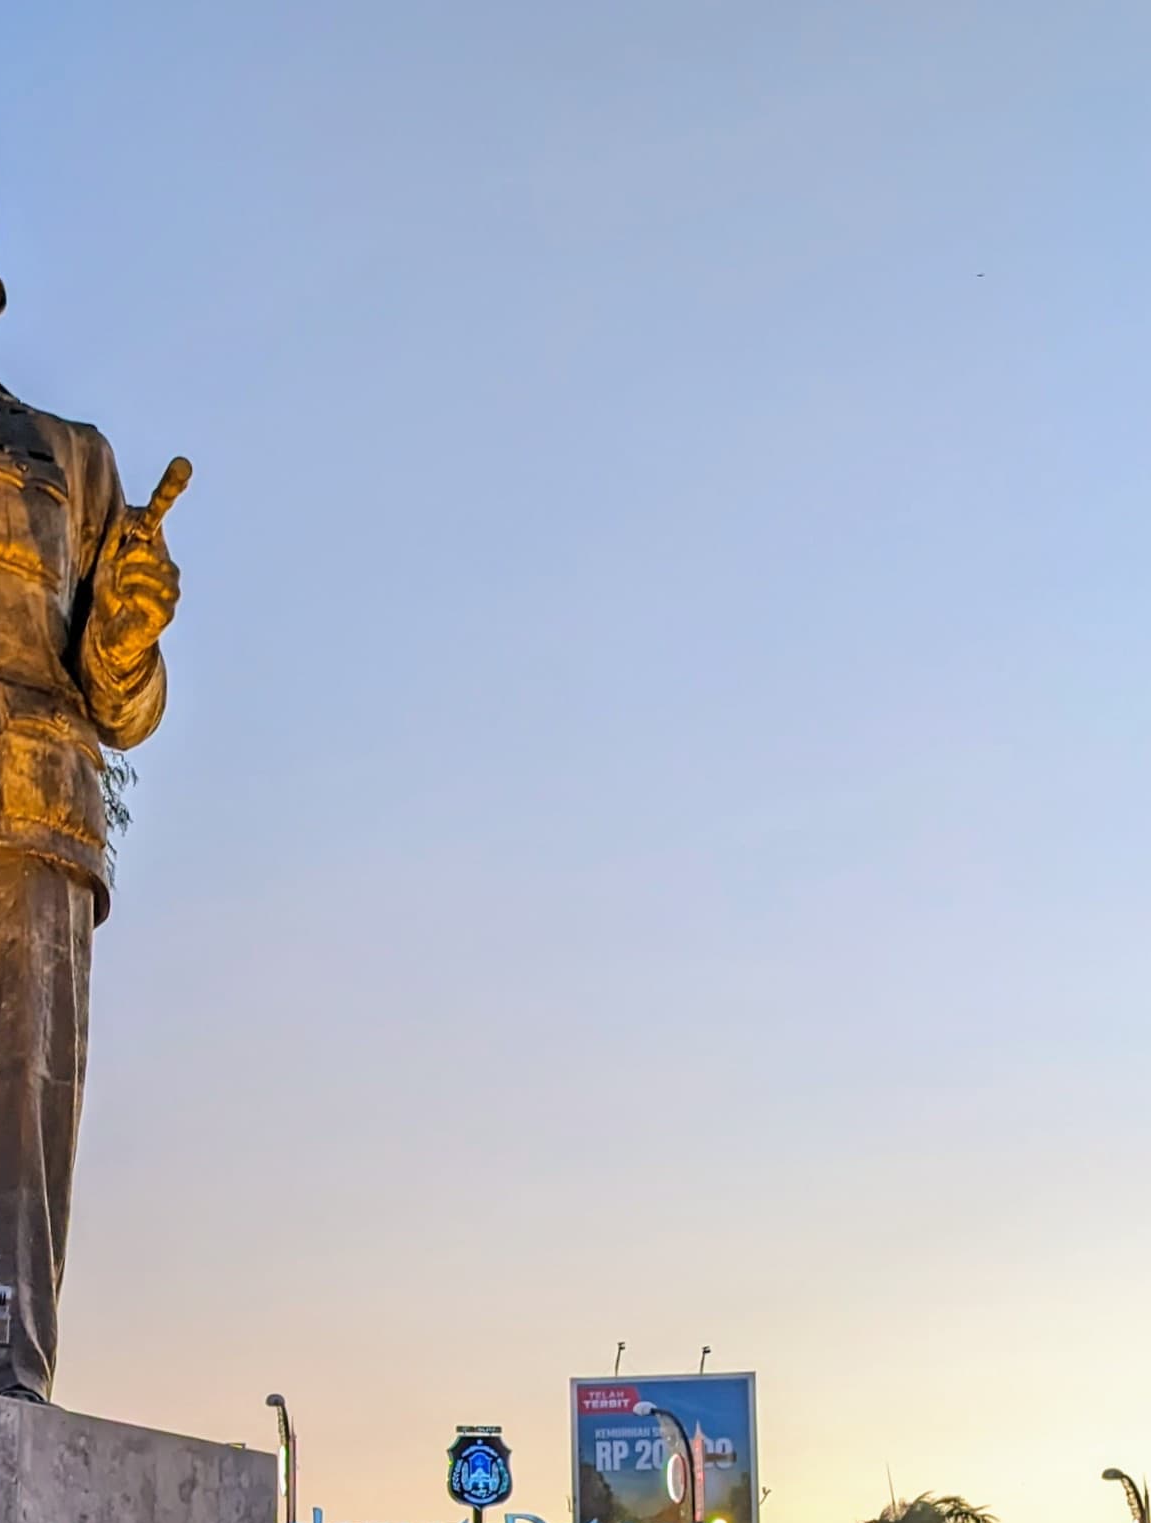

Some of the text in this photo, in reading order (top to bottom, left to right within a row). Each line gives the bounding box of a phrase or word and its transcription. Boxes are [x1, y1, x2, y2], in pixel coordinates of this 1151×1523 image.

[588, 1390, 625, 1400] TELAH
[583, 1399, 630, 1409] TERBIT
[595, 1440, 629, 1472] RP
